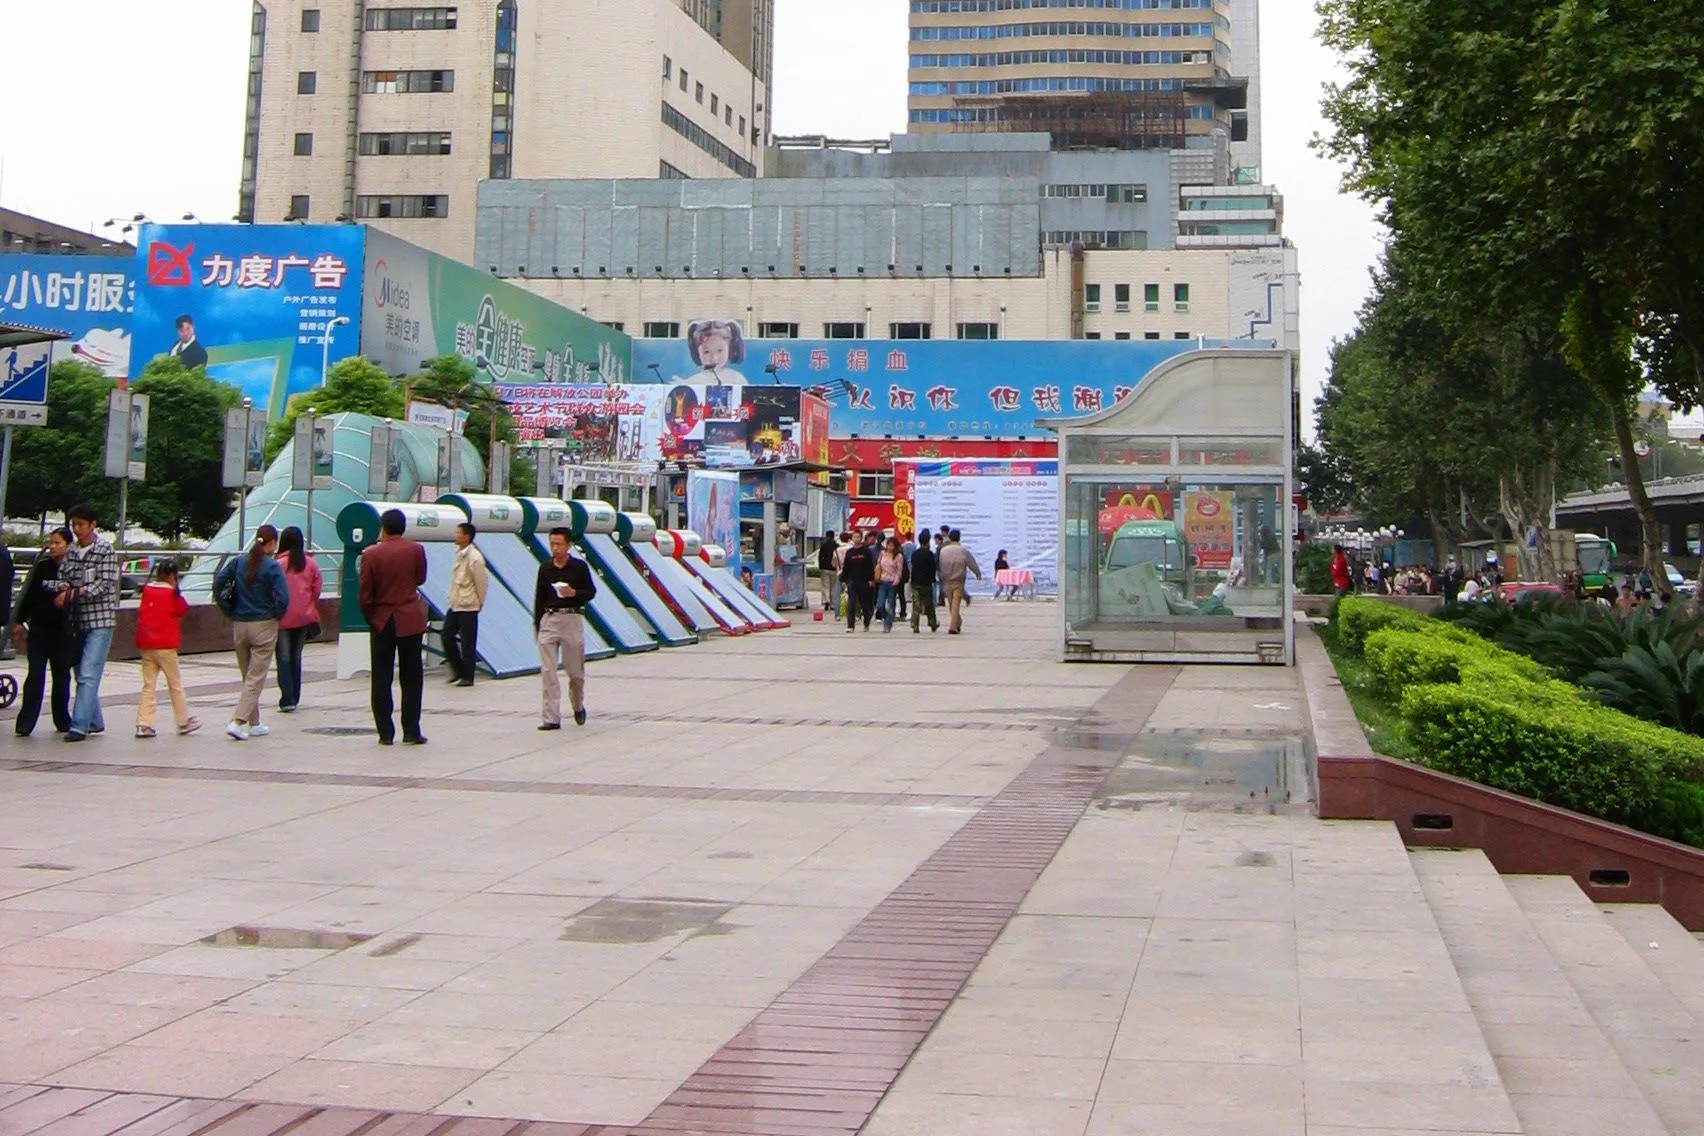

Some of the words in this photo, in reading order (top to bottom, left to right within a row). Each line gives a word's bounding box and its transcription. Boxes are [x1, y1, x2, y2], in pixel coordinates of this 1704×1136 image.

[202, 254, 347, 289] 力度广告
[0, 270, 135, 313] 小时服
[769, 347, 909, 372] 快乐捐血
